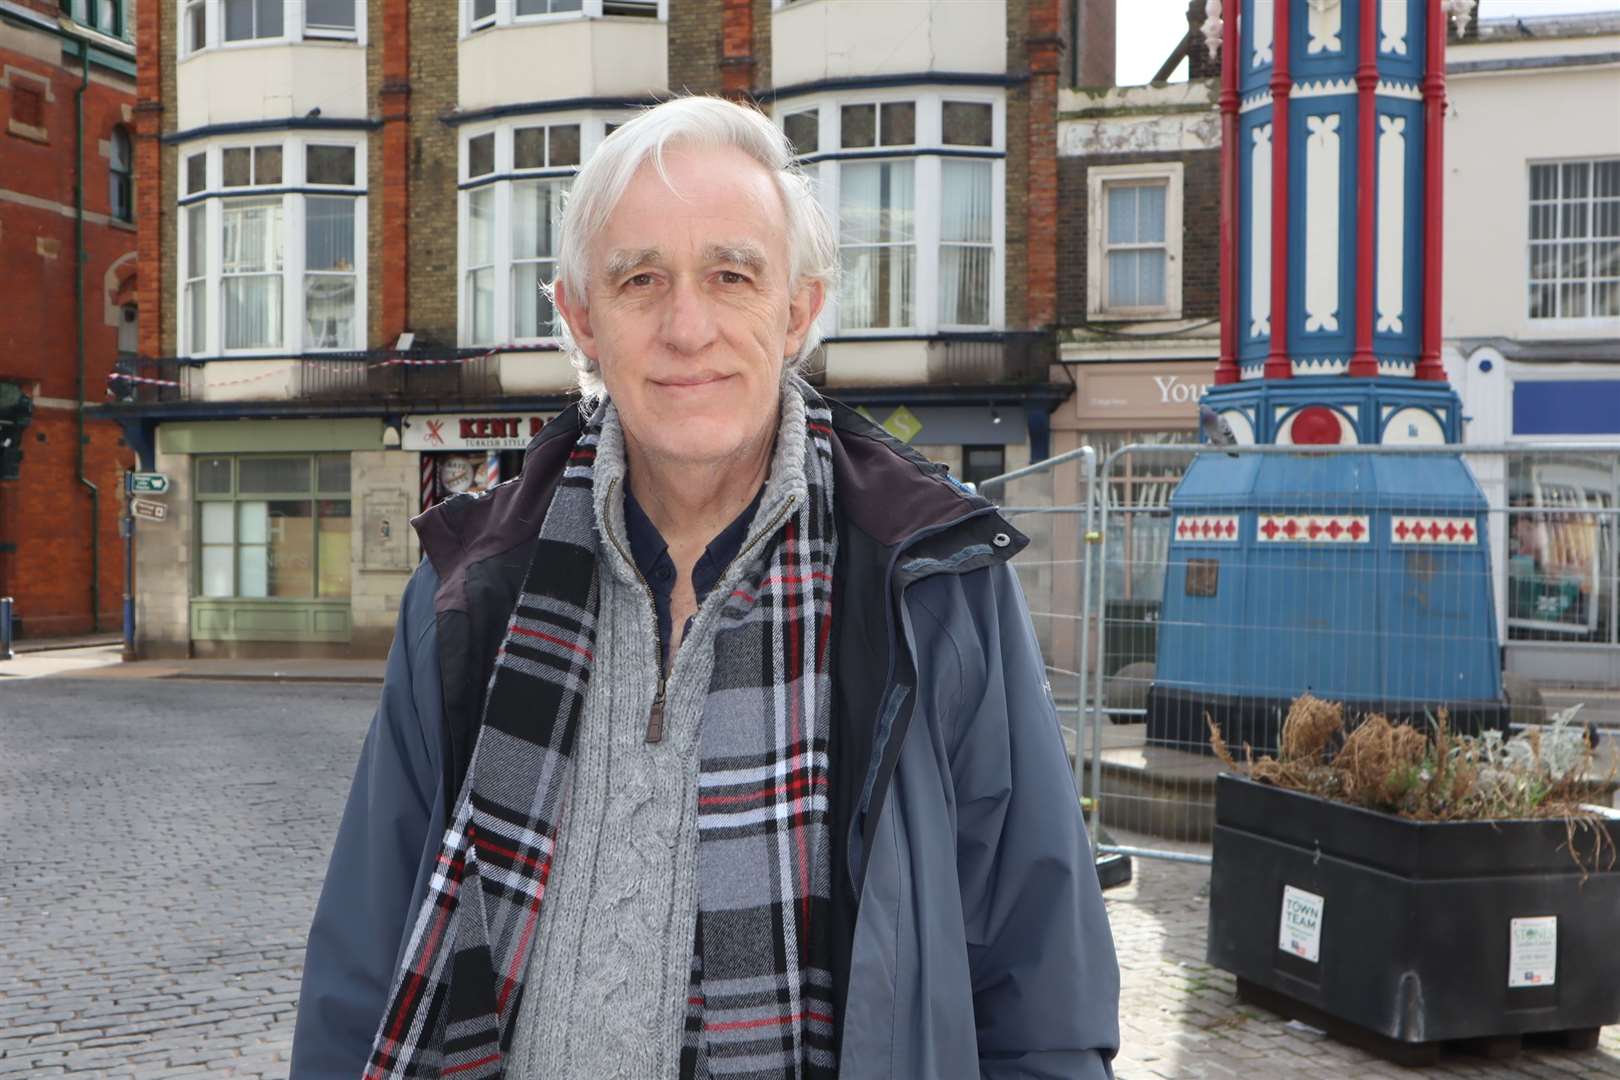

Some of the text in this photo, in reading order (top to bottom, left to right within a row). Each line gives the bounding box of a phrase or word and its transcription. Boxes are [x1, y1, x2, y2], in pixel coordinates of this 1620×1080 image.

[1153, 375, 1213, 403] You
[459, 417, 521, 439] KENT
[465, 439, 526, 447] TURKISH STYLE
[1287, 899, 1319, 919] TOWN
[1287, 912, 1316, 929] TEAM
